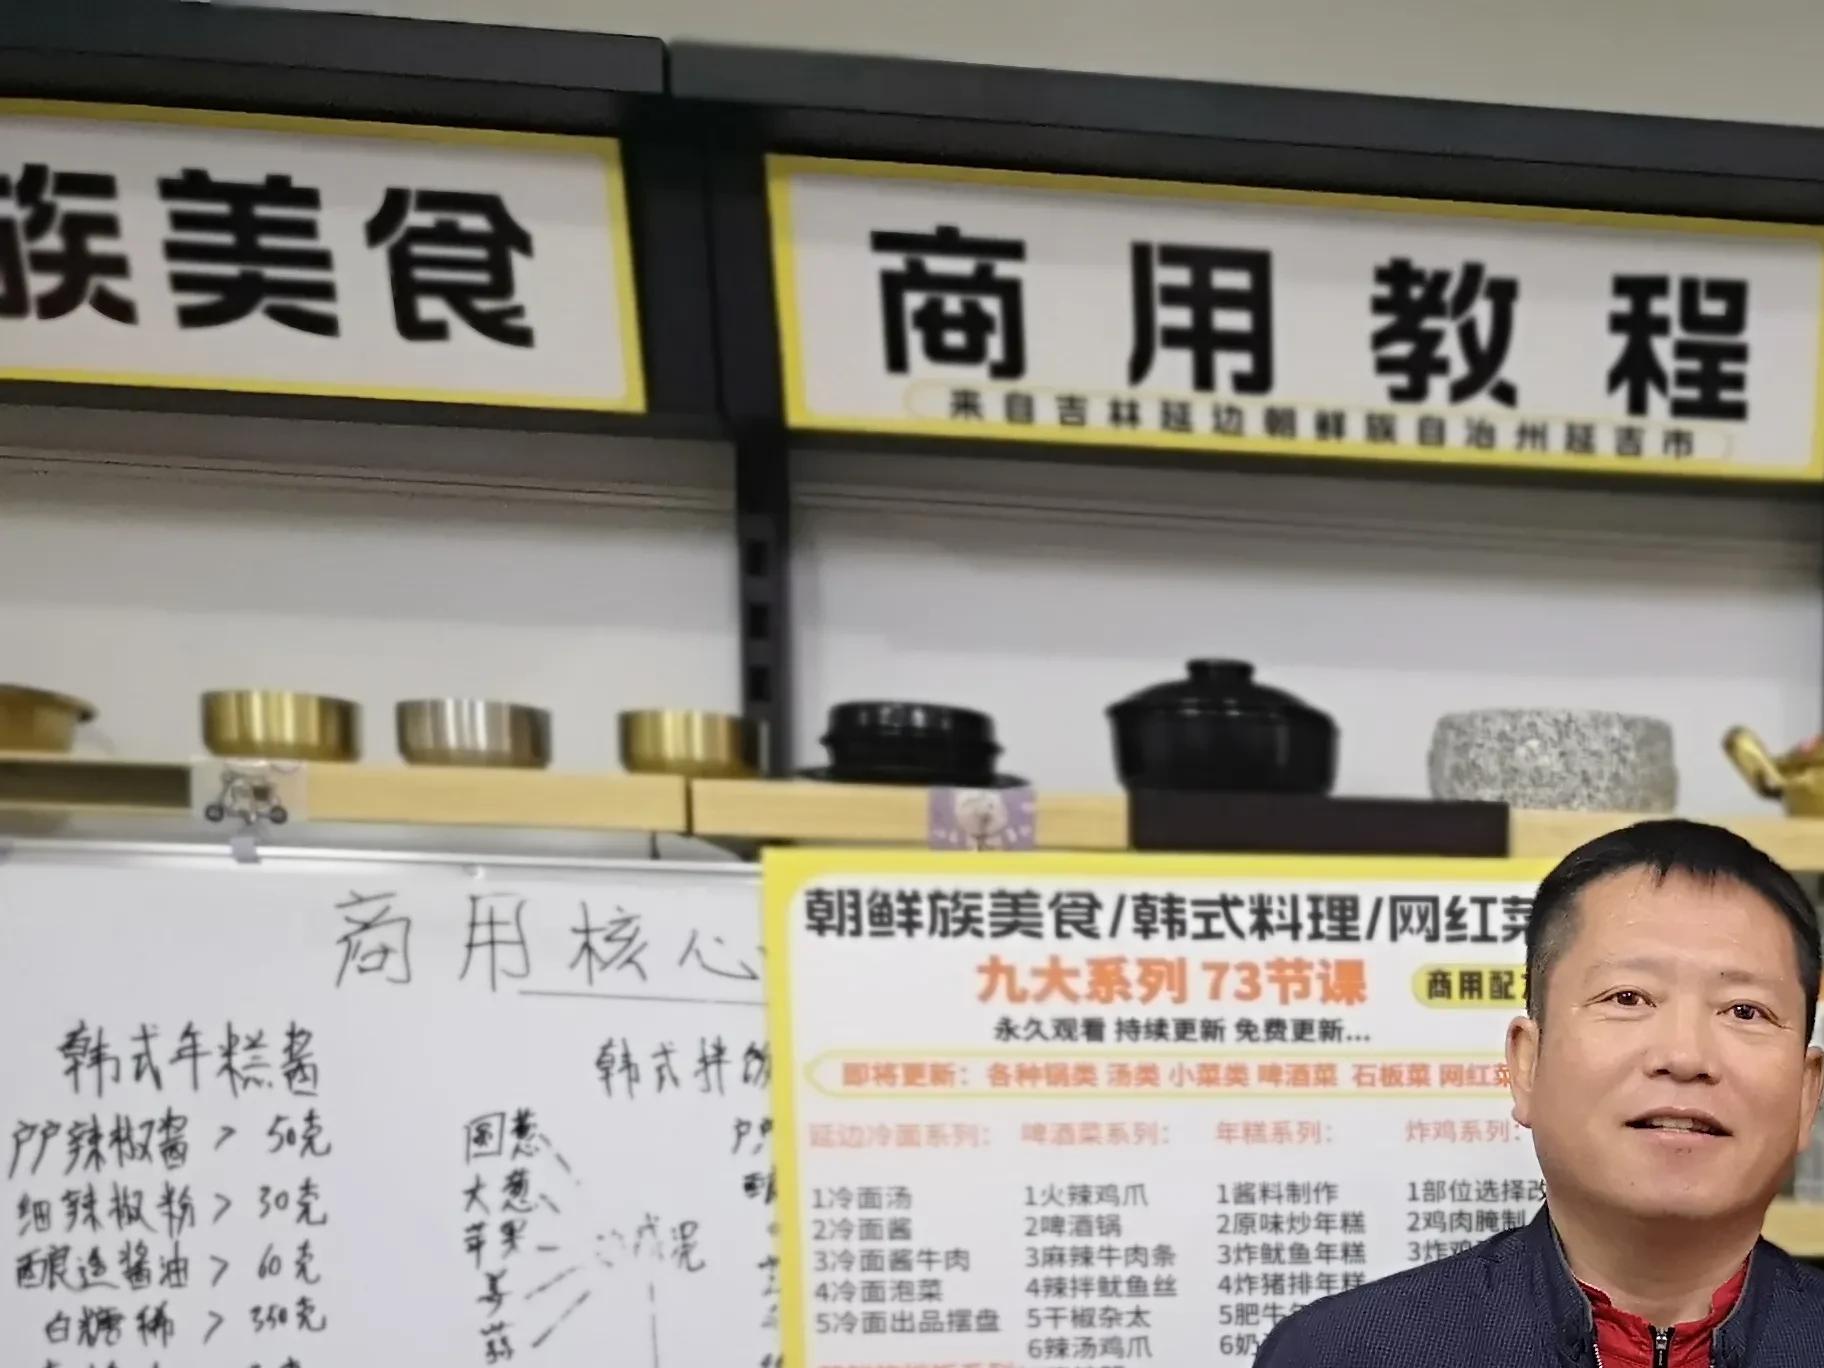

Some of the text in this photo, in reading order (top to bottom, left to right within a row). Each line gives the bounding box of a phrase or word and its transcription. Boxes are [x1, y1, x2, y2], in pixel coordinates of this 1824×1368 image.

[0, 163, 535, 349] 族美食
[870, 226, 1749, 421] 商用教程
[950, 389, 1696, 459] 来自吉林延边朝鲜族自治州延吉市
[976, 956, 1368, 1006] 九大系列 73节课
[1427, 968, 1528, 1000] 商用配
[994, 1018, 1107, 1043] 永久观看
[1115, 1018, 1227, 1043] 持续更新
[57, 1019, 318, 1099] 韩式年糕酱
[841, 1062, 971, 1088] 即将更新：
[987, 1062, 1098, 1089] 各种锅类
[1107, 1063, 1161, 1089] 汤类
[1168, 1063, 1250, 1089] 小菜类
[1258, 1064, 1338, 1089] 啤酒菜
[1352, 1064, 1431, 1088] 石板菜
[266, 1107, 332, 1158] 50克
[812, 1185, 913, 1210] 1冷面汤
[1024, 1183, 1149, 1207] 1火辣鸡爪
[1217, 1180, 1340, 1205] 1酱料制作
[16, 1180, 196, 1239] 细辣椒粉
[258, 1176, 327, 1226] 30克
[811, 1216, 913, 1241] 2冷面酱
[1024, 1213, 1123, 1238] 2啤酒锅
[1217, 1210, 1367, 1236] 2原味炒年糕
[1407, 1208, 1527, 1234] 2鸡肉腌制
[16, 1239, 189, 1292] 酿造酱油
[257, 1238, 321, 1285] 60克
[813, 1247, 971, 1272] 3冷面酱牛肉
[1024, 1243, 1177, 1269] 3麻辣牛肉条
[1217, 1241, 1367, 1266] 3炸鱿鱼年糕
[814, 1278, 944, 1304] 4冷面泡菜
[1024, 1274, 1178, 1299] 4辣拌鱿鱼丝
[816, 1308, 1002, 1334] 5冷面出品摆盘
[1027, 1335, 1153, 1360] 6辣汤鸡爪
